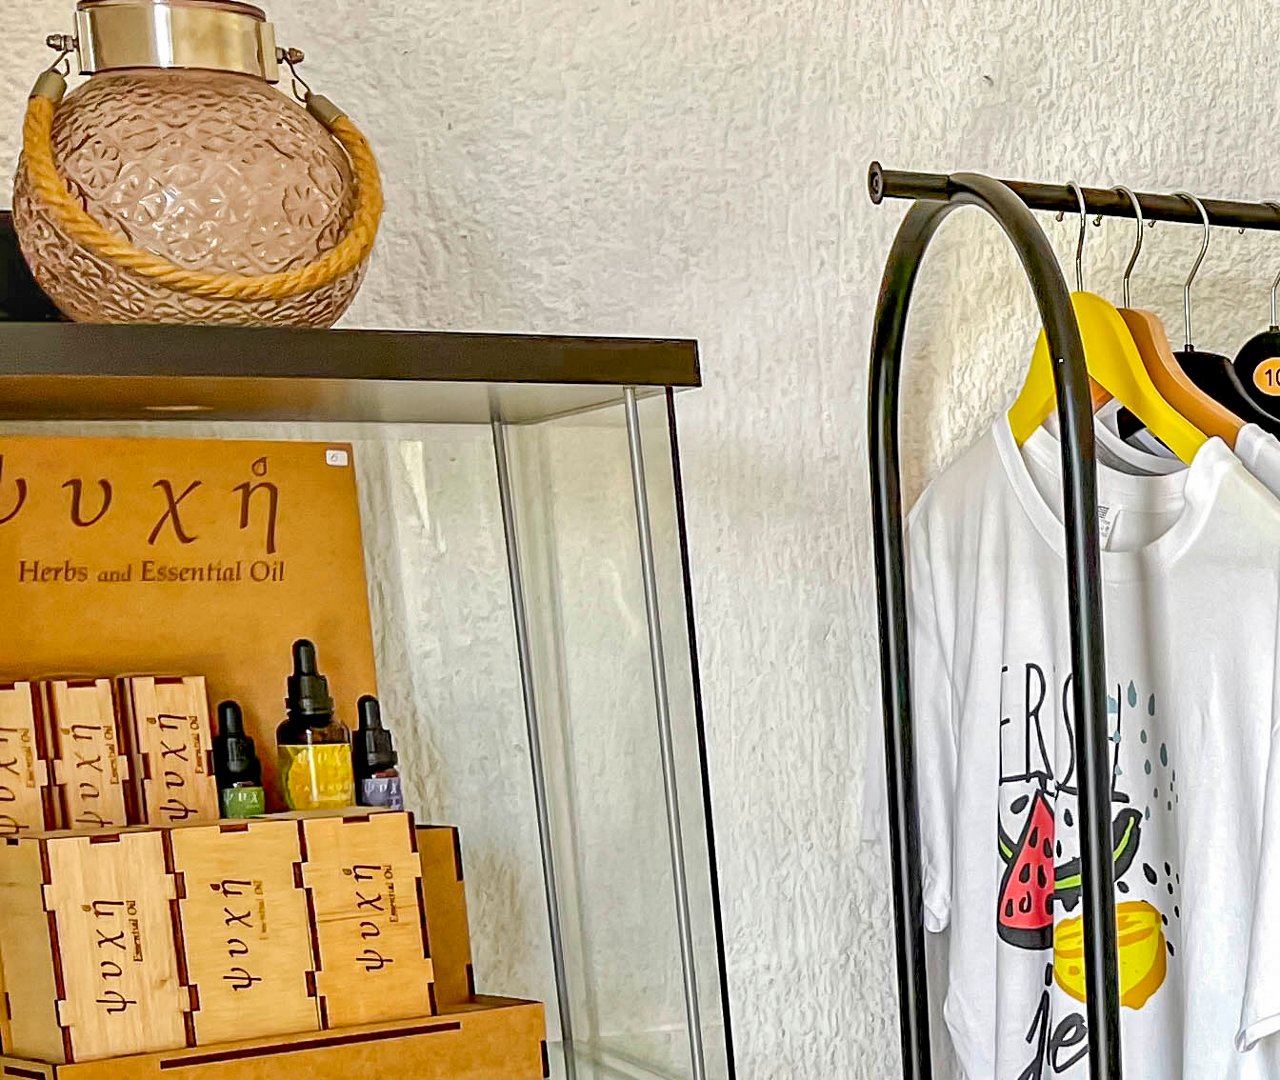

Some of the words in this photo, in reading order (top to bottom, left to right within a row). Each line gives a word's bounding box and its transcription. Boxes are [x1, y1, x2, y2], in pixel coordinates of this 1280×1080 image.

[19, 561, 89, 583] Herbs
[97, 564, 132, 583] and
[141, 560, 241, 583] Essential
[250, 561, 285, 583] Oil
